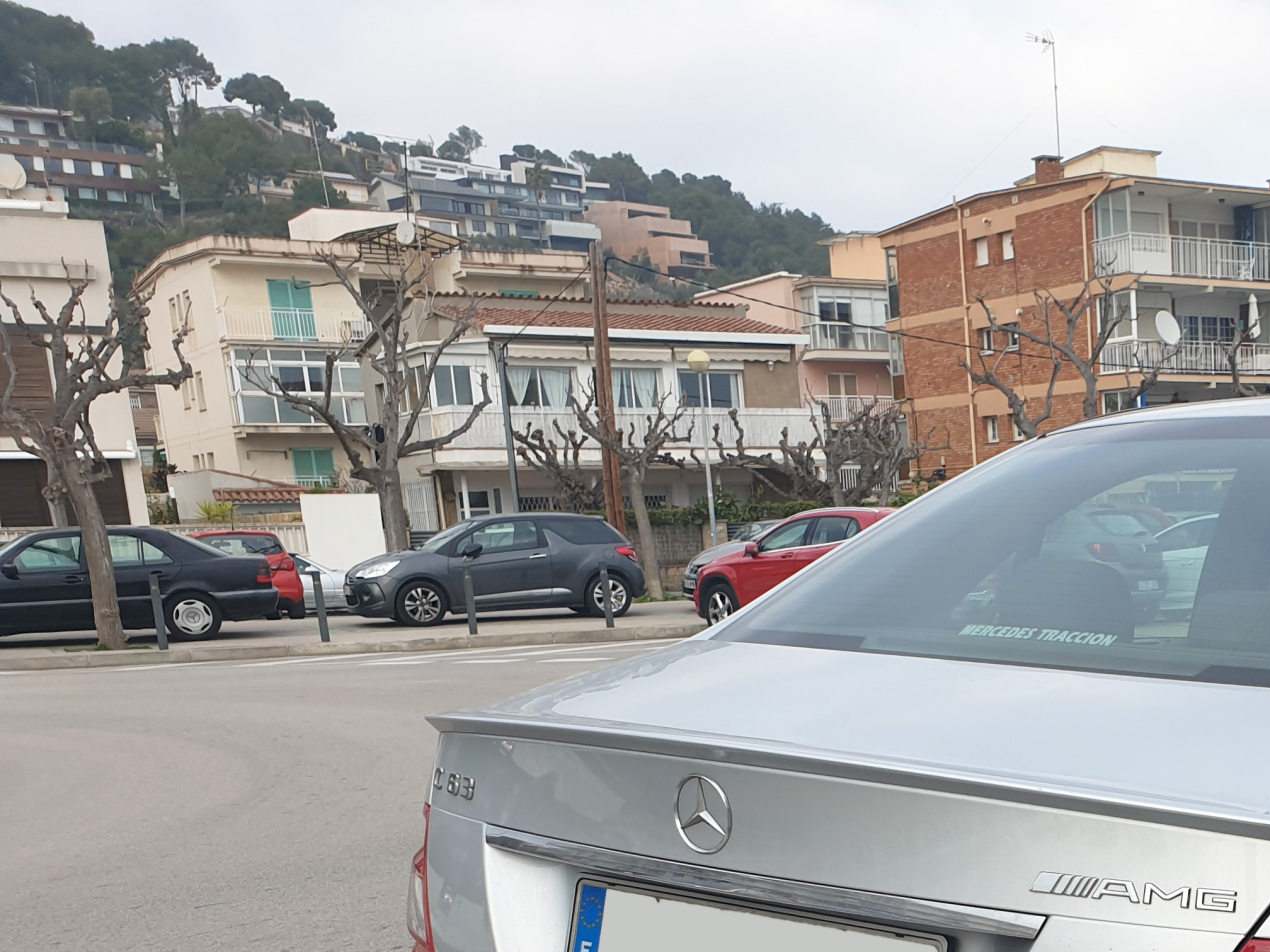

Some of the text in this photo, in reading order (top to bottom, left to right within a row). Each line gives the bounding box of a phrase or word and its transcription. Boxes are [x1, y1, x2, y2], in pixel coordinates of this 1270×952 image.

[958, 624, 1118, 647] MERCEDES TRACCION
[447, 773, 475, 800] 63
[1091, 877, 1238, 913] AMG
